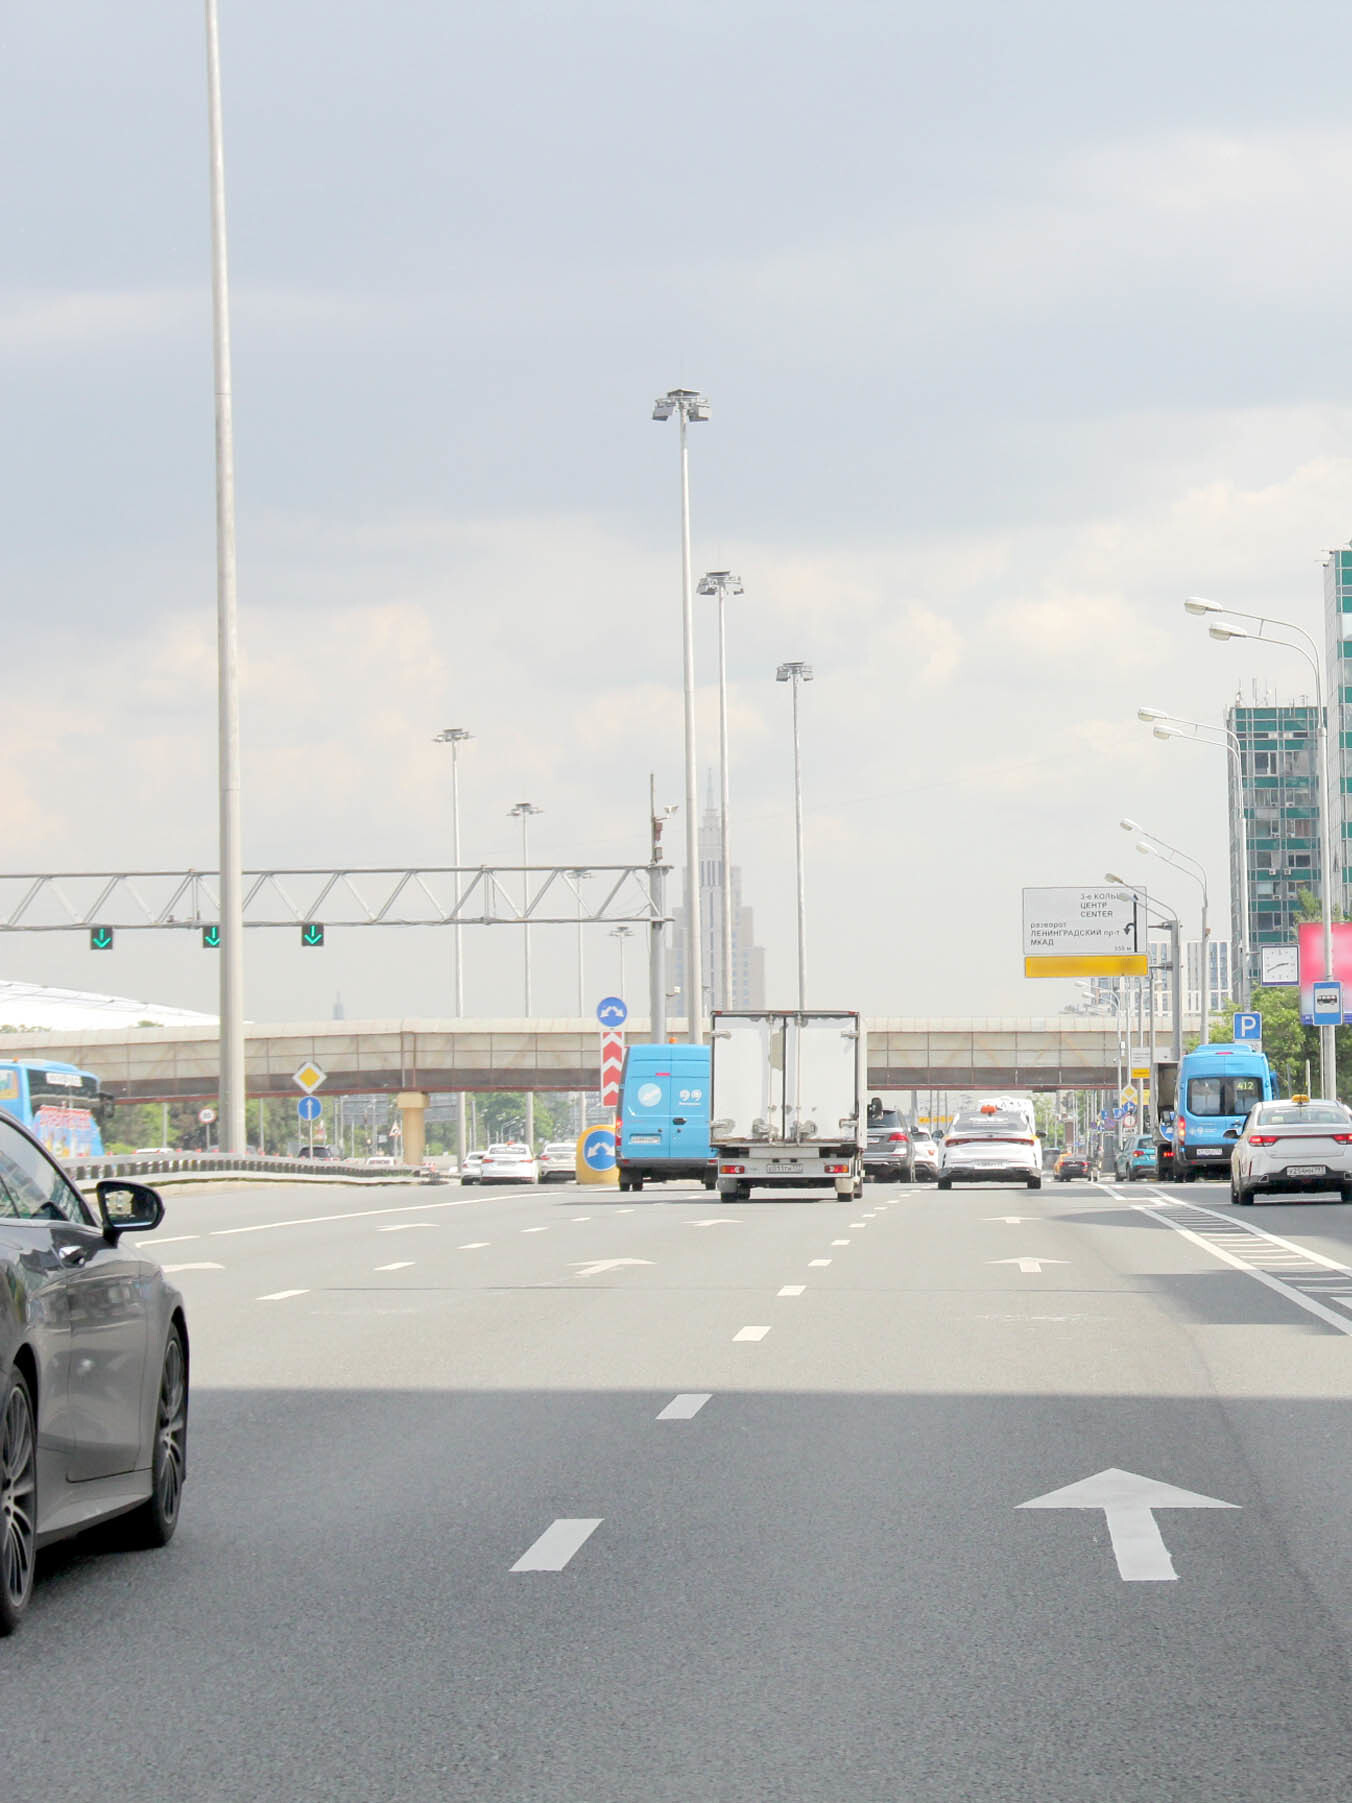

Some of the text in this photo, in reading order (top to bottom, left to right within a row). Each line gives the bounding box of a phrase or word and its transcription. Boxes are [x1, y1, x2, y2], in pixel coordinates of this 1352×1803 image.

[1080, 901, 1108, 909] ЦЕНТР
[1080, 910, 1113, 918] CENTER
[1030, 928, 1102, 937] ЛЕНИНГРАДСКИЙ
[1030, 938, 1054, 946] МКАД
[1241, 1015, 1257, 1038] P
[1236, 1080, 1254, 1091] 412
